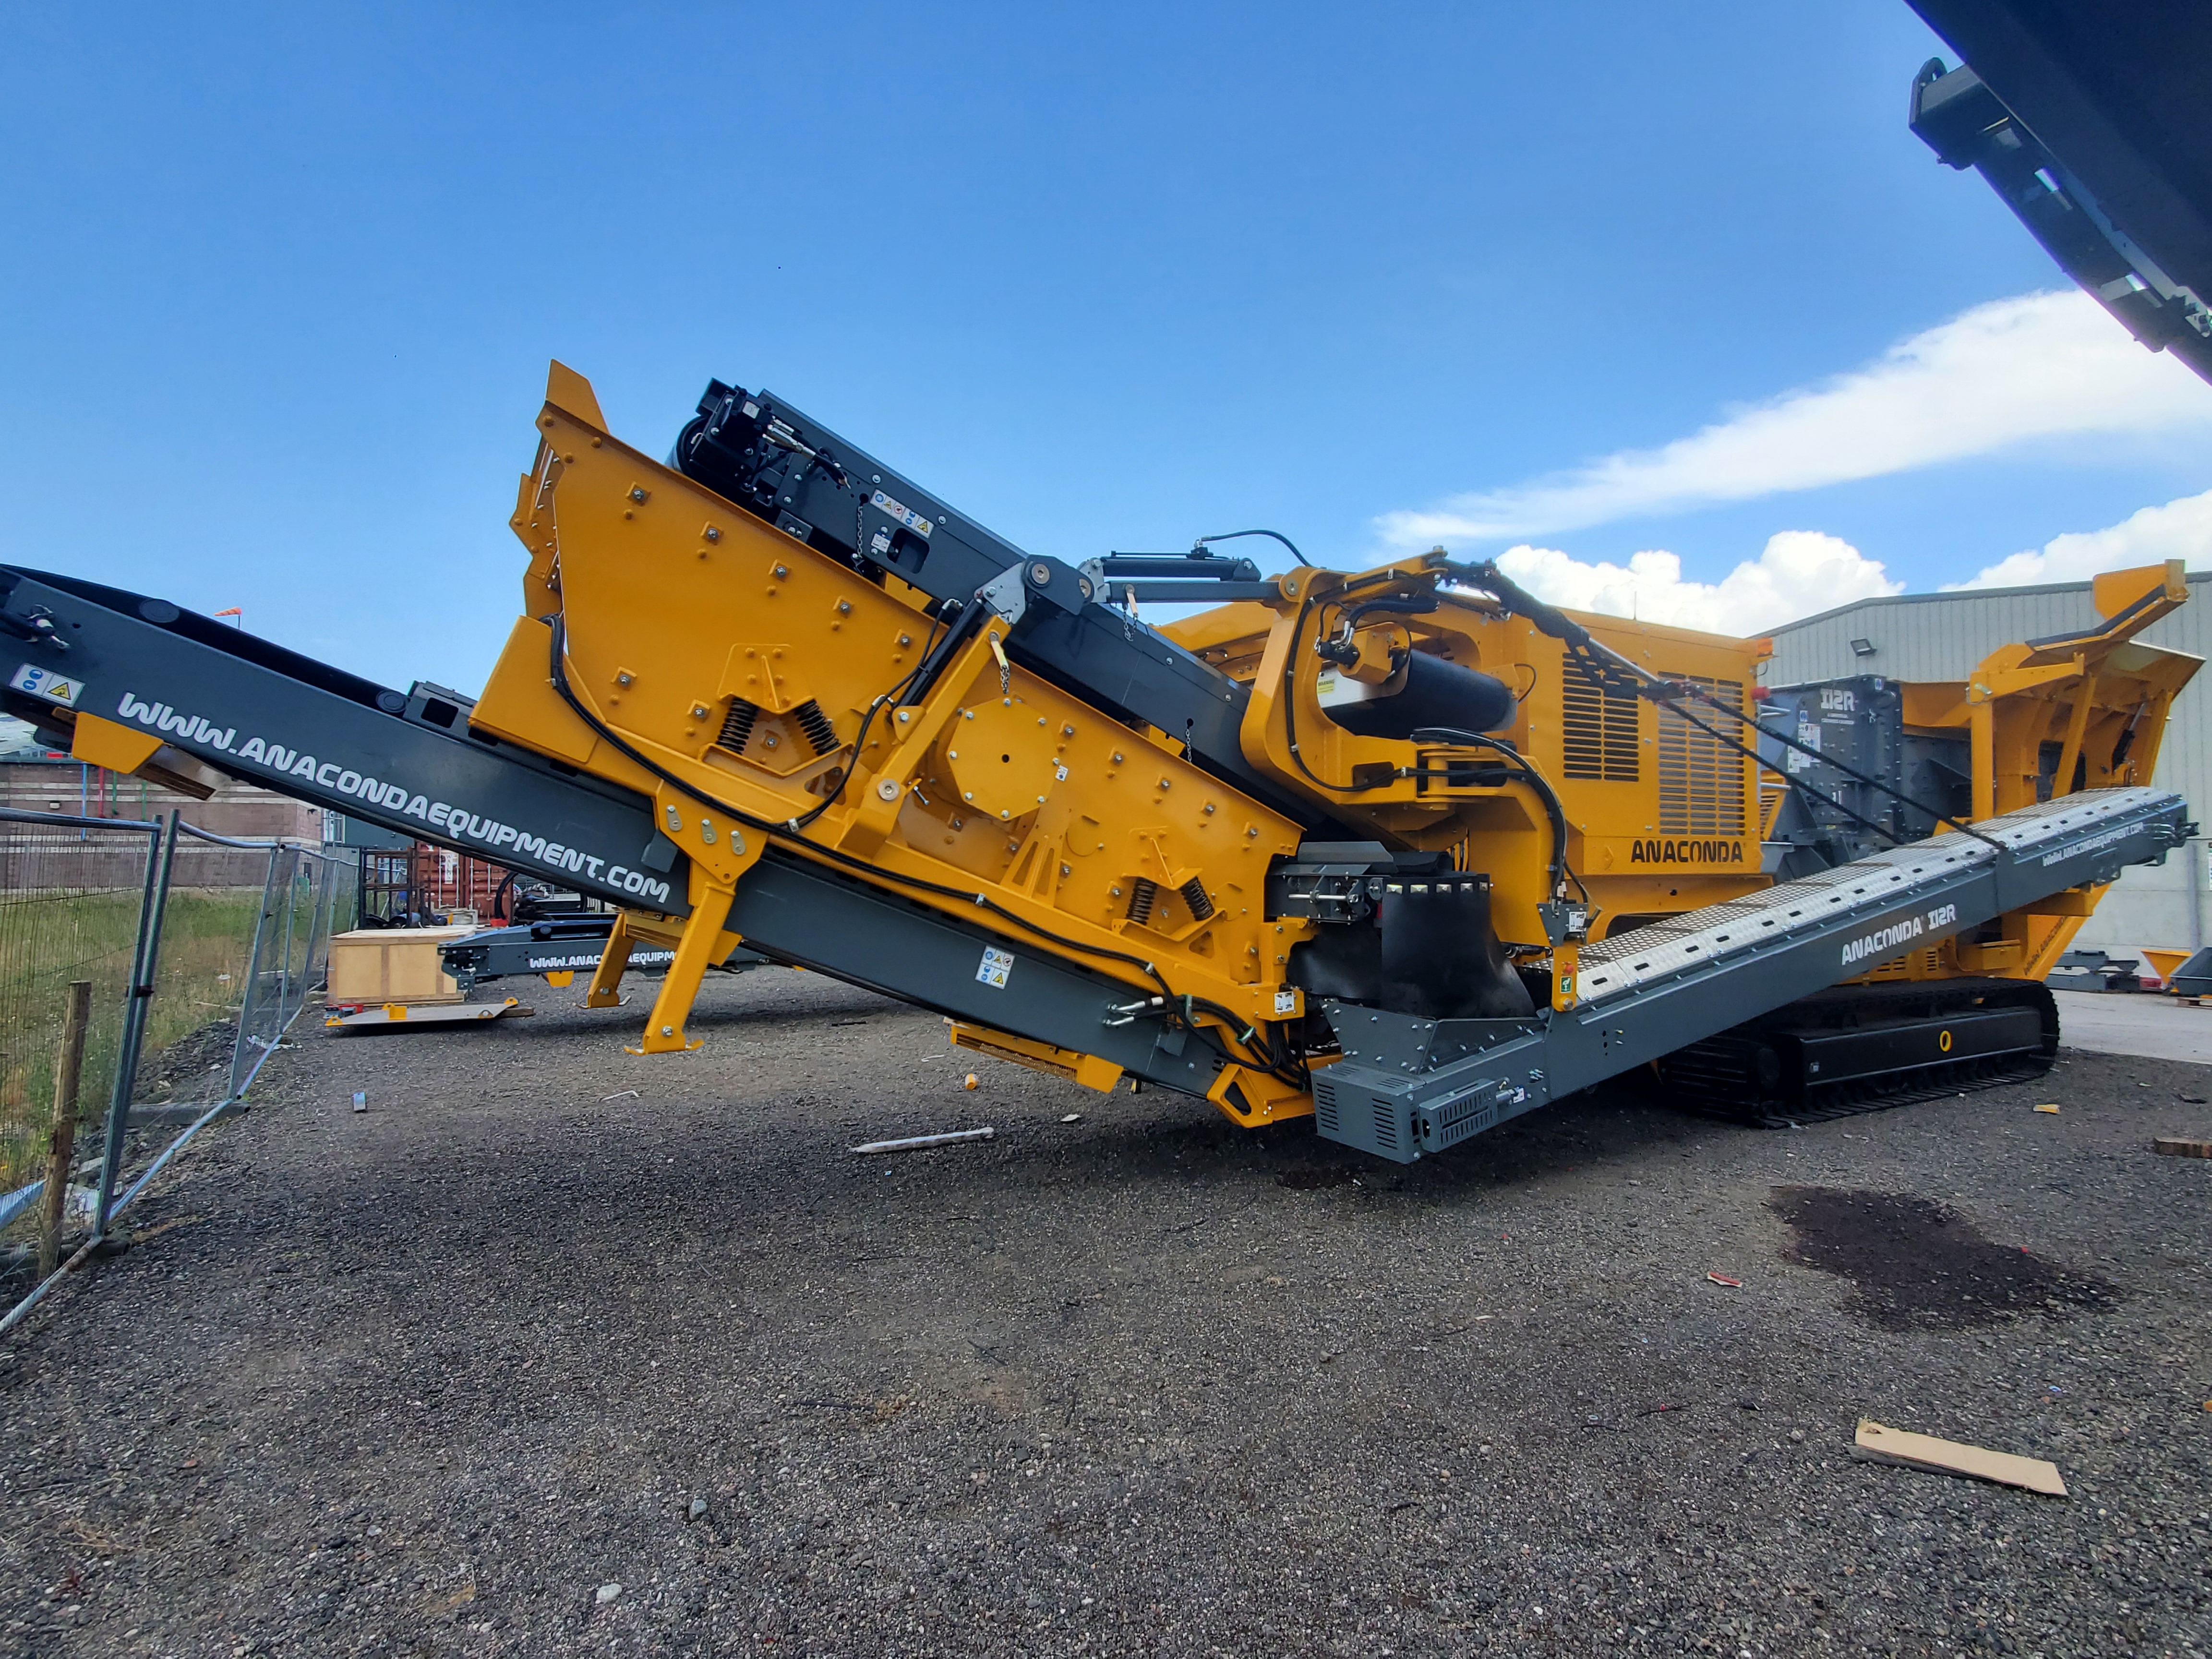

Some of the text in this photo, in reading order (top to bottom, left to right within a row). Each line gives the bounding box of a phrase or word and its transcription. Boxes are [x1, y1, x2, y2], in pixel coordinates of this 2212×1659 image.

[118, 692, 670, 903] WWW.ANACONDAEQUIPMENT.COM
[1631, 840, 1743, 863] ANACONDA
[1841, 916, 1923, 966] ANACONDA
